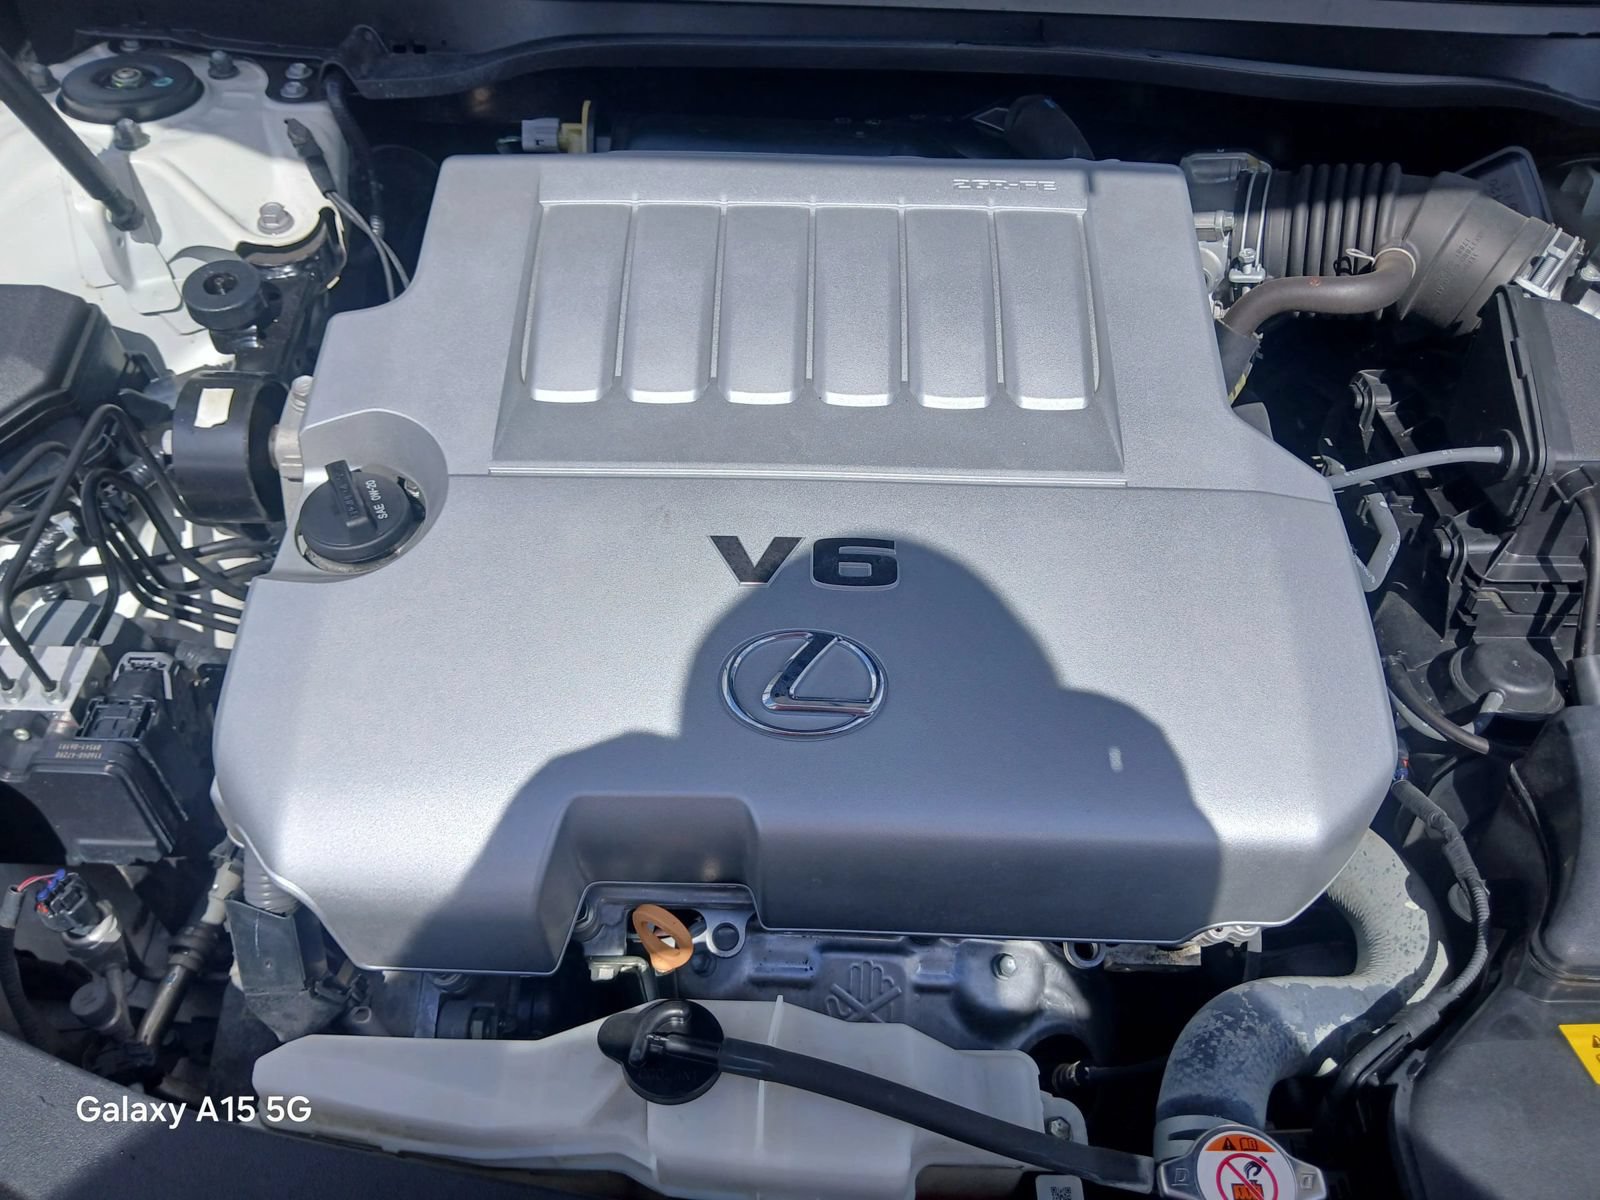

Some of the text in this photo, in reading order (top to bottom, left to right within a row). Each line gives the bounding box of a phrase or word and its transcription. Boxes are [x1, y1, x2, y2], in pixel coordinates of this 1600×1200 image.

[952, 178, 1058, 192] 2GR-FE
[365, 479, 389, 520] SAE 0W-20
[707, 535, 901, 591] V6
